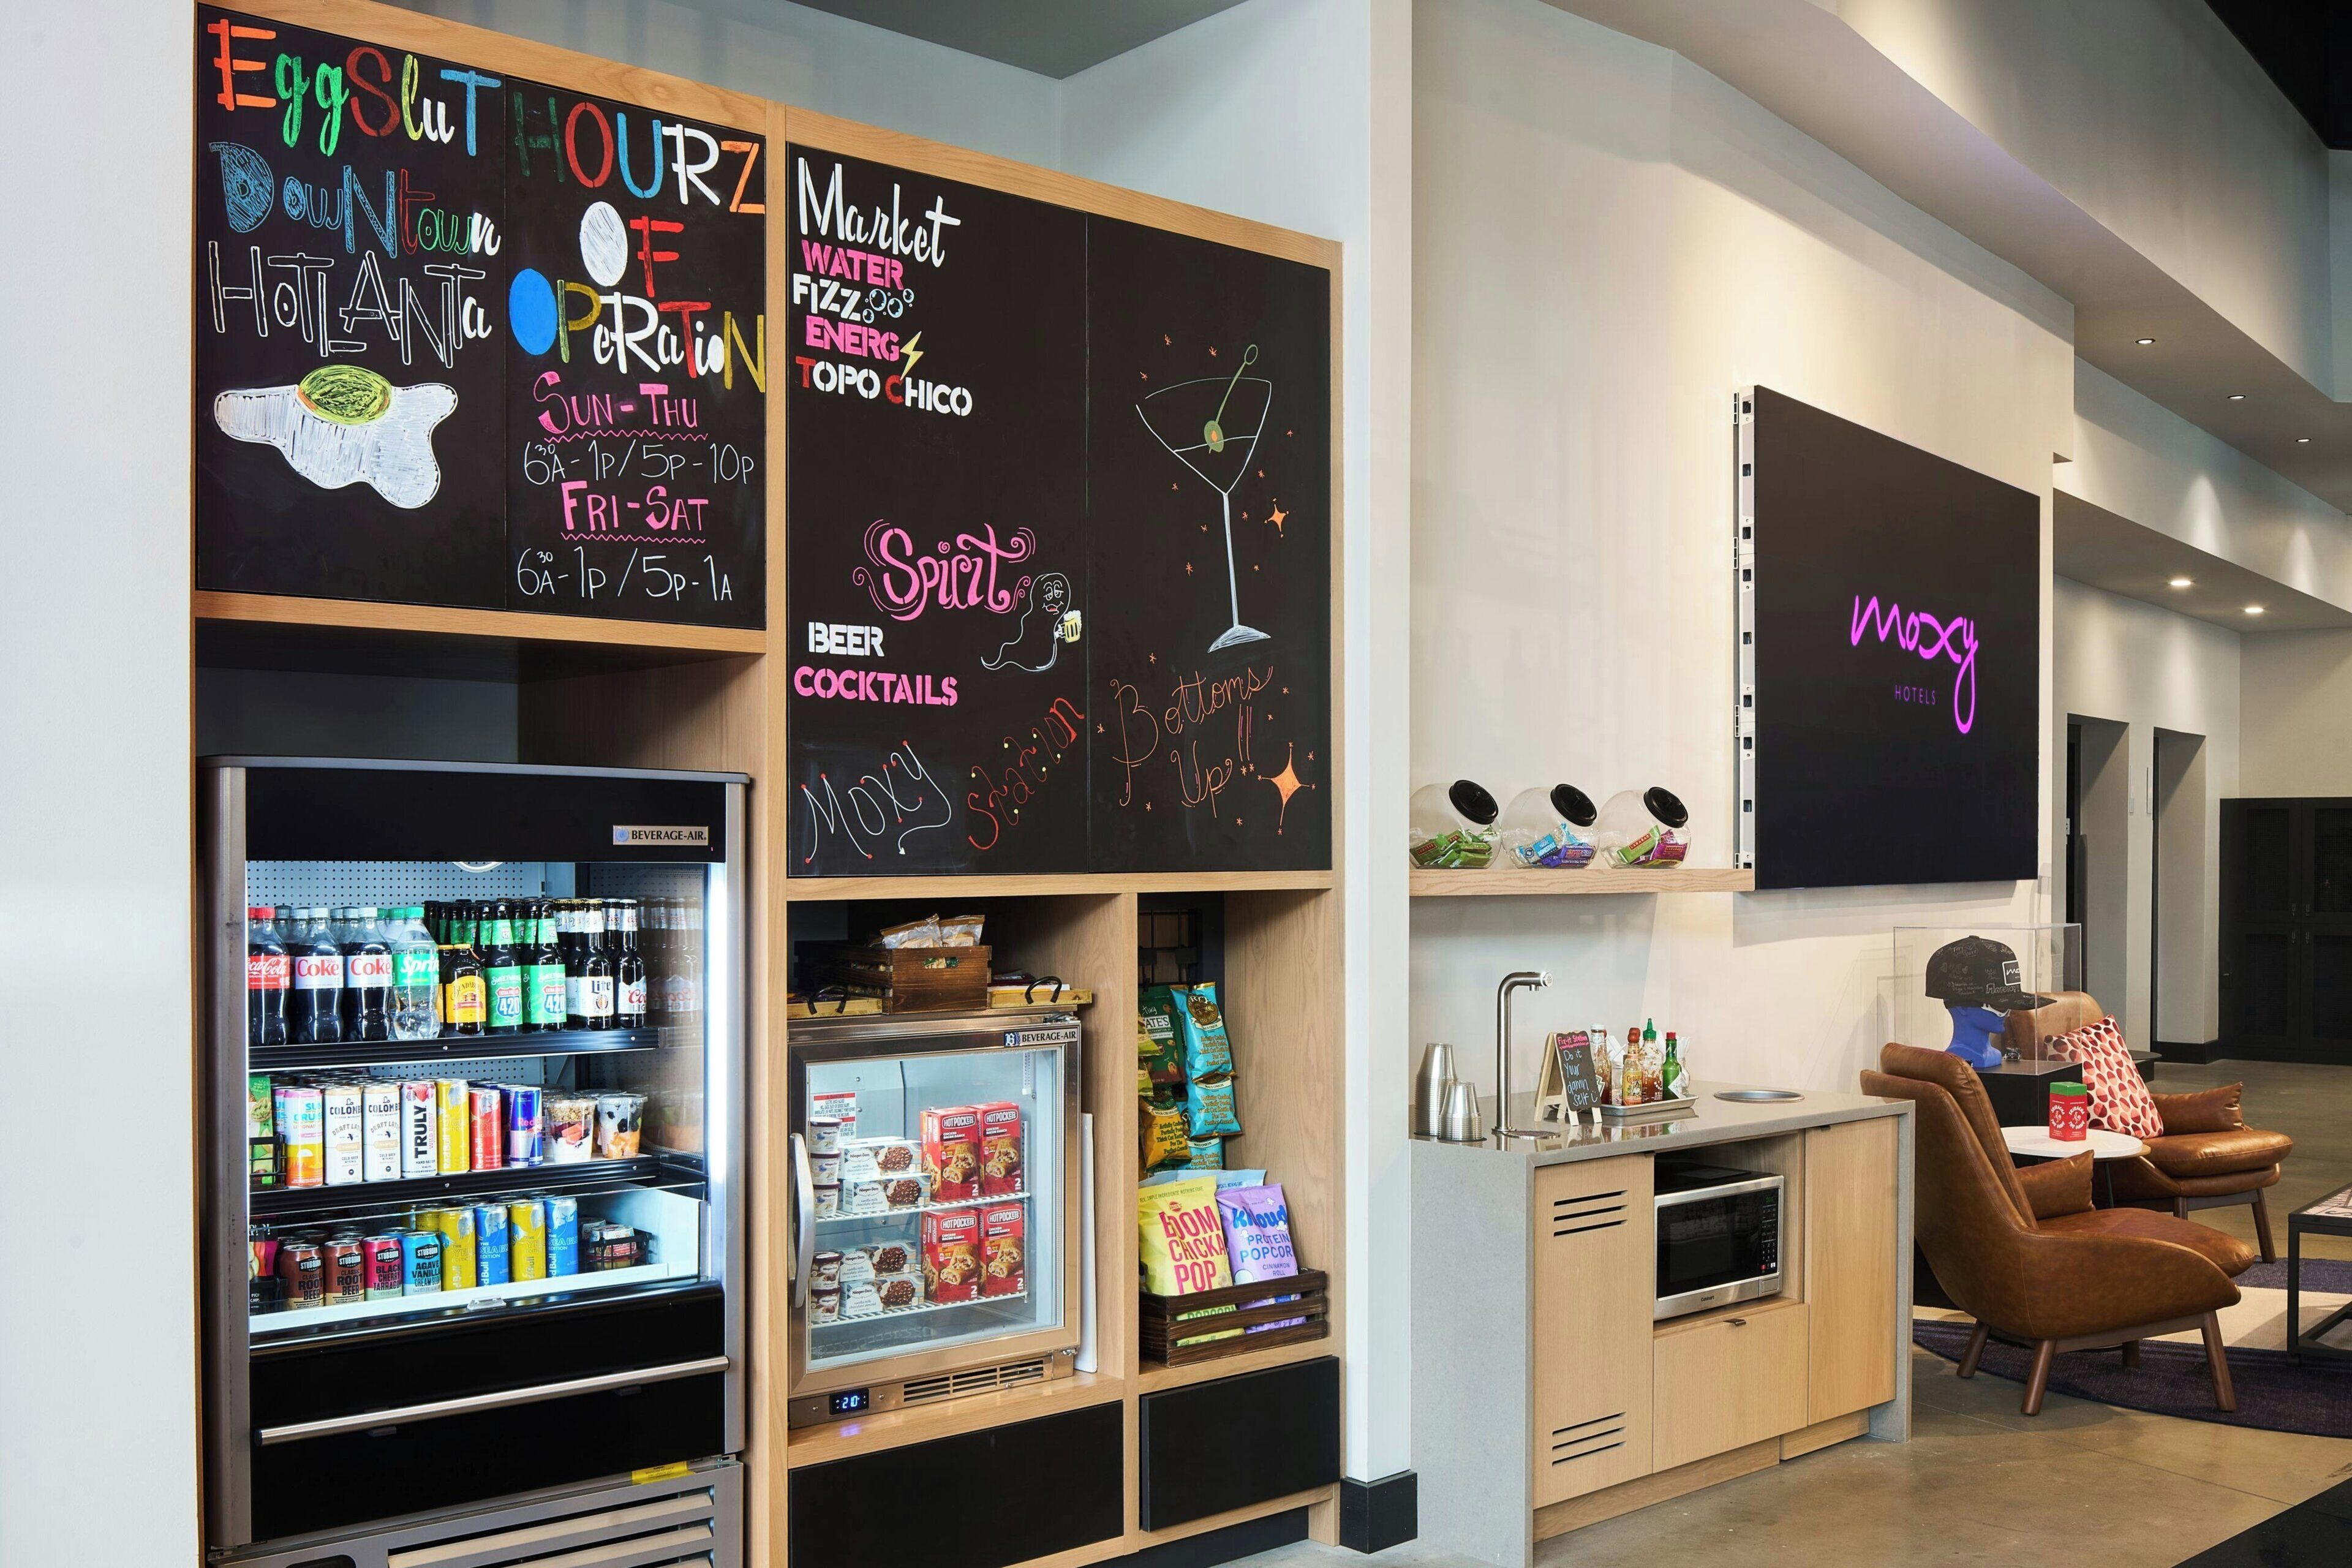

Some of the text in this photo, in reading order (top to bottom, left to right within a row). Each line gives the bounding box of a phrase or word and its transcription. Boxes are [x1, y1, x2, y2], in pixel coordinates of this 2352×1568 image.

[513, 92, 765, 214] HOURZ
[798, 157, 961, 267] Market
[801, 239, 903, 290] WATER
[796, 356, 973, 417] TOPO CHICO
[870, 522, 1027, 621] Spirit
[808, 621, 884, 657] BEER
[1851, 595, 1978, 734] moxy
[794, 666, 958, 706] COCKTAILS
[1895, 685, 1936, 705] HOTELS
[1110, 666, 1273, 806] Bottoms
[298, 959, 339, 977] Coke
[350, 958, 391, 976] Coke
[591, 981, 611, 993] Lite
[499, 997, 520, 1016] 420
[546, 994, 565, 1014] 420
[1142, 1005, 1157, 1015] tiny
[1145, 1017, 1169, 1028] ATE'S
[1022, 1031, 1076, 1042] BEVERAGE-AIR
[1564, 1049, 1581, 1061] Do it
[1567, 1079, 1589, 1095] damn
[330, 1105, 362, 1115] COLOMB
[369, 1102, 401, 1113] COLOMB
[986, 1110, 1016, 1122] HOT POCKETS
[944, 1117, 974, 1128] HOT POCKETS
[414, 1105, 427, 1159] TRULY
[972, 1184, 978, 1193] 2
[1015, 1178, 1021, 1187] 2
[943, 1217, 974, 1229] HOT POCKETS
[989, 1211, 1019, 1223] HOT POCKETS
[1247, 1234, 1290, 1246] PROTEIN
[1240, 1246, 1293, 1263] POPCOR
[376, 1264, 401, 1274] BLACK
[416, 1260, 439, 1270] AGAVE
[412, 1268, 440, 1278] VANILL
[1174, 1261, 1216, 1295] POP
[298, 1278, 323, 1291] ROOT
[337, 1273, 363, 1286] ROOT
[374, 1280, 401, 1291] TARRAGO
[415, 1277, 431, 1287] CREAM
[1017, 1278, 1023, 1286] 2
[303, 1289, 320, 1300] BEER
[342, 1284, 360, 1295] BEER
[971, 1286, 978, 1294] 2
